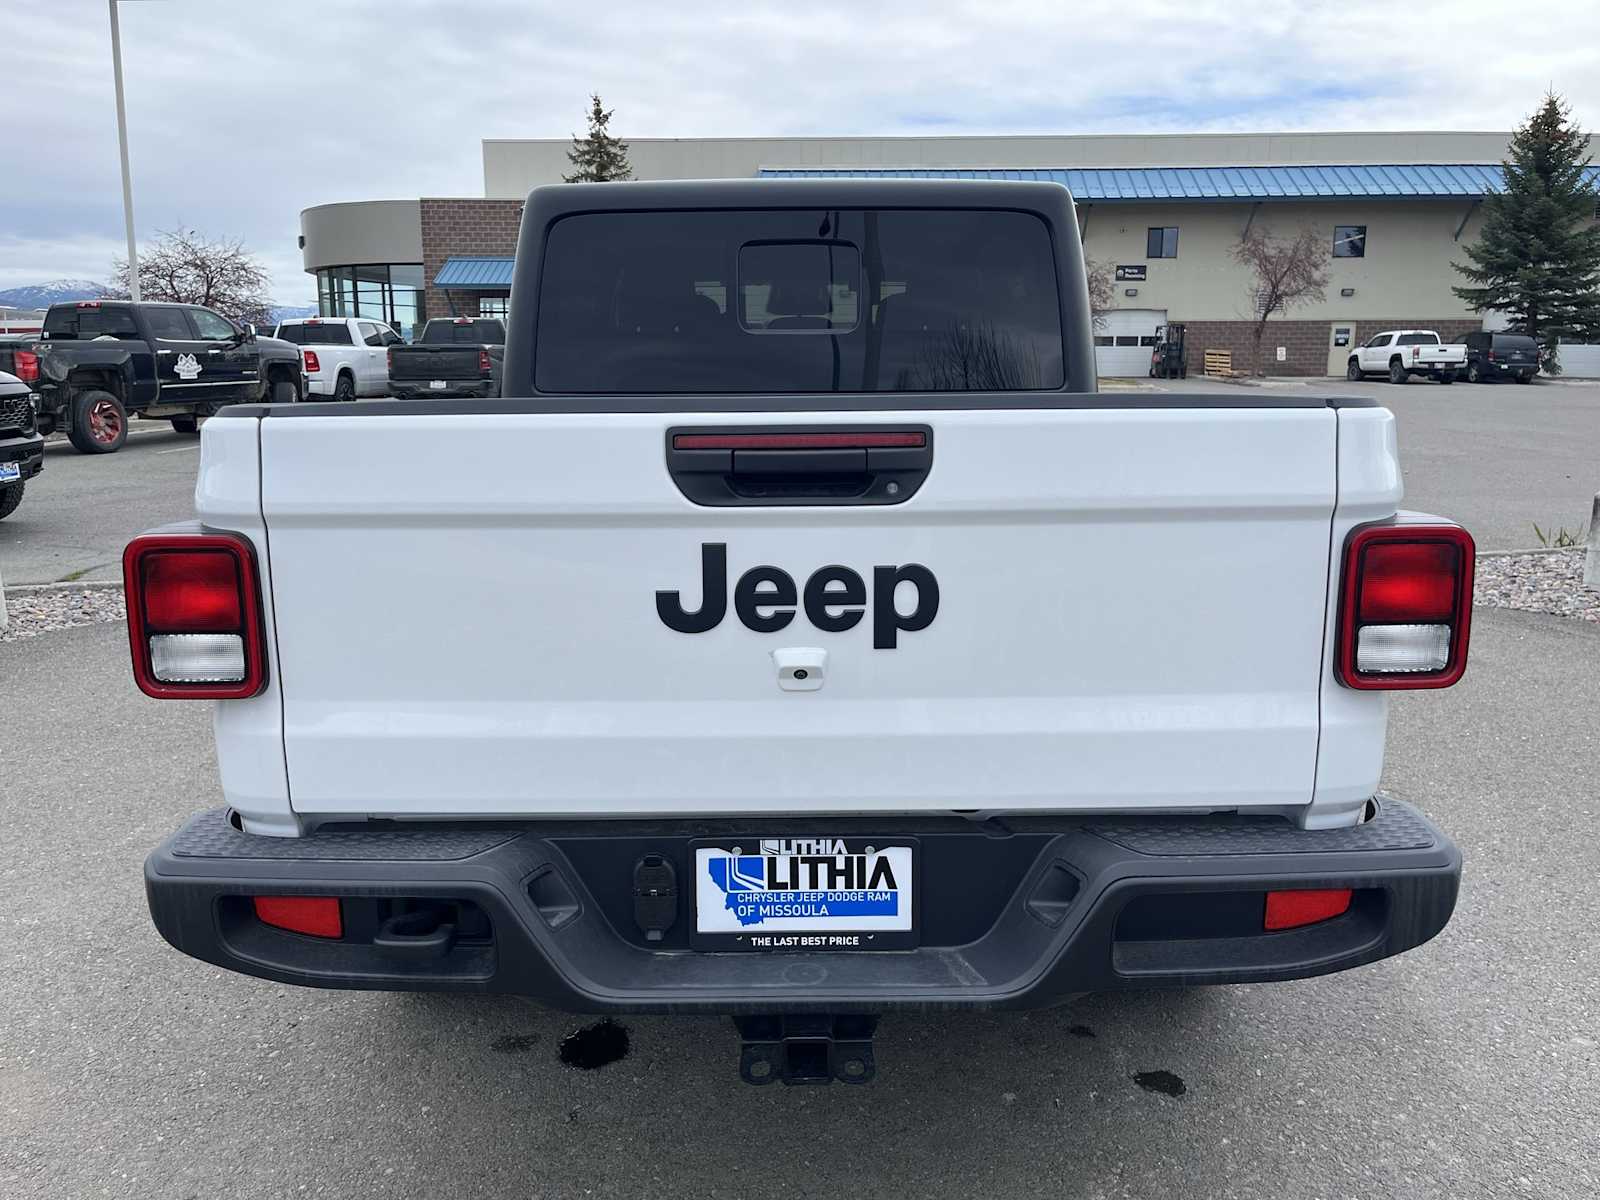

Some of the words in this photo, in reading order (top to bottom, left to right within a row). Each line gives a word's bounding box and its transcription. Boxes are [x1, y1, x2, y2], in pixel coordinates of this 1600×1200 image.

[655, 542, 940, 650] Jeep
[779, 839, 849, 855] LITHIA
[767, 856, 898, 890] LITHIA
[737, 892, 795, 902] CHRYSLER
[797, 892, 825, 902] JEEP
[827, 892, 865, 902] DODGE
[867, 891, 891, 901] RAM
[737, 905, 755, 916] OF
[759, 904, 829, 916] MISSOULA
[751, 937, 772, 946] THE
[773, 937, 799, 946] LAST
[801, 936, 827, 945] BEST
[829, 936, 860, 946] PRICE
